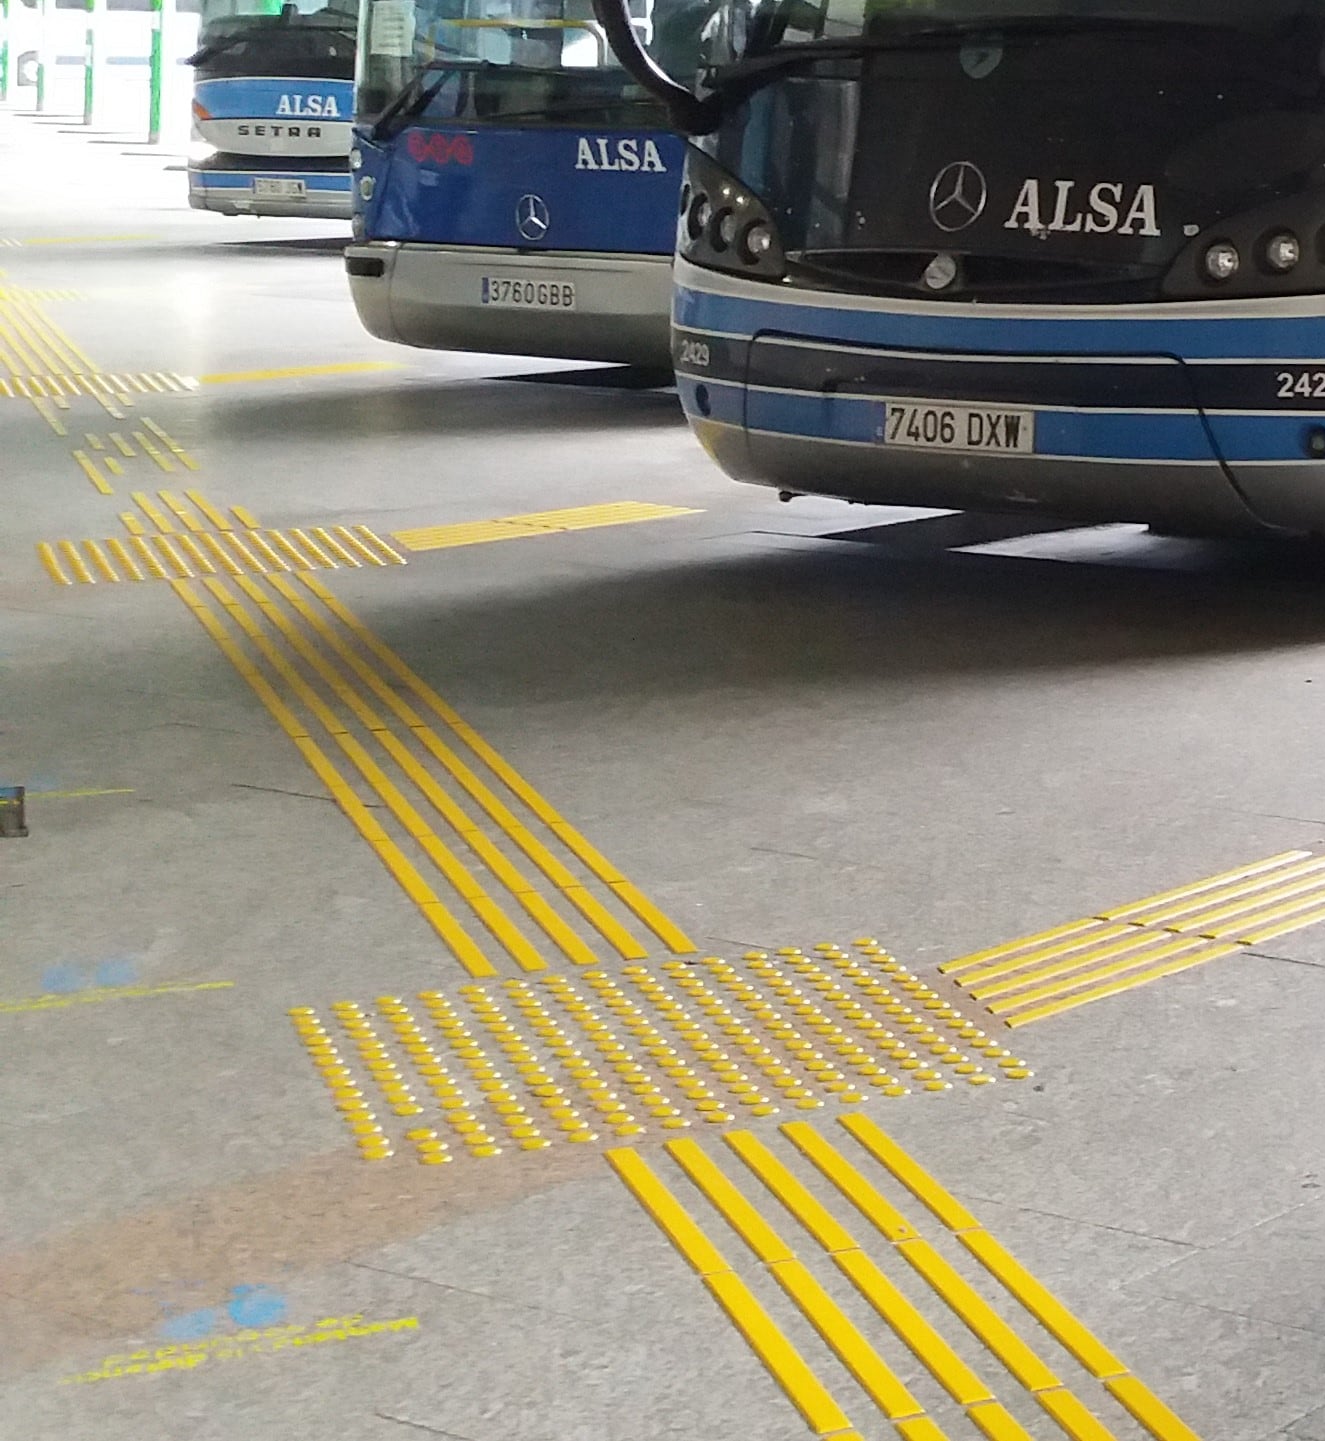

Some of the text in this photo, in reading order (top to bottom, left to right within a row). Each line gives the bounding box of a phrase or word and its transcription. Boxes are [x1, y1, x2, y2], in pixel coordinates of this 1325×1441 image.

[275, 94, 341, 117] ALSA
[575, 137, 668, 172] ALSA
[1004, 179, 1161, 236] ALSA
[889, 408, 1021, 448] 7406 DXW
